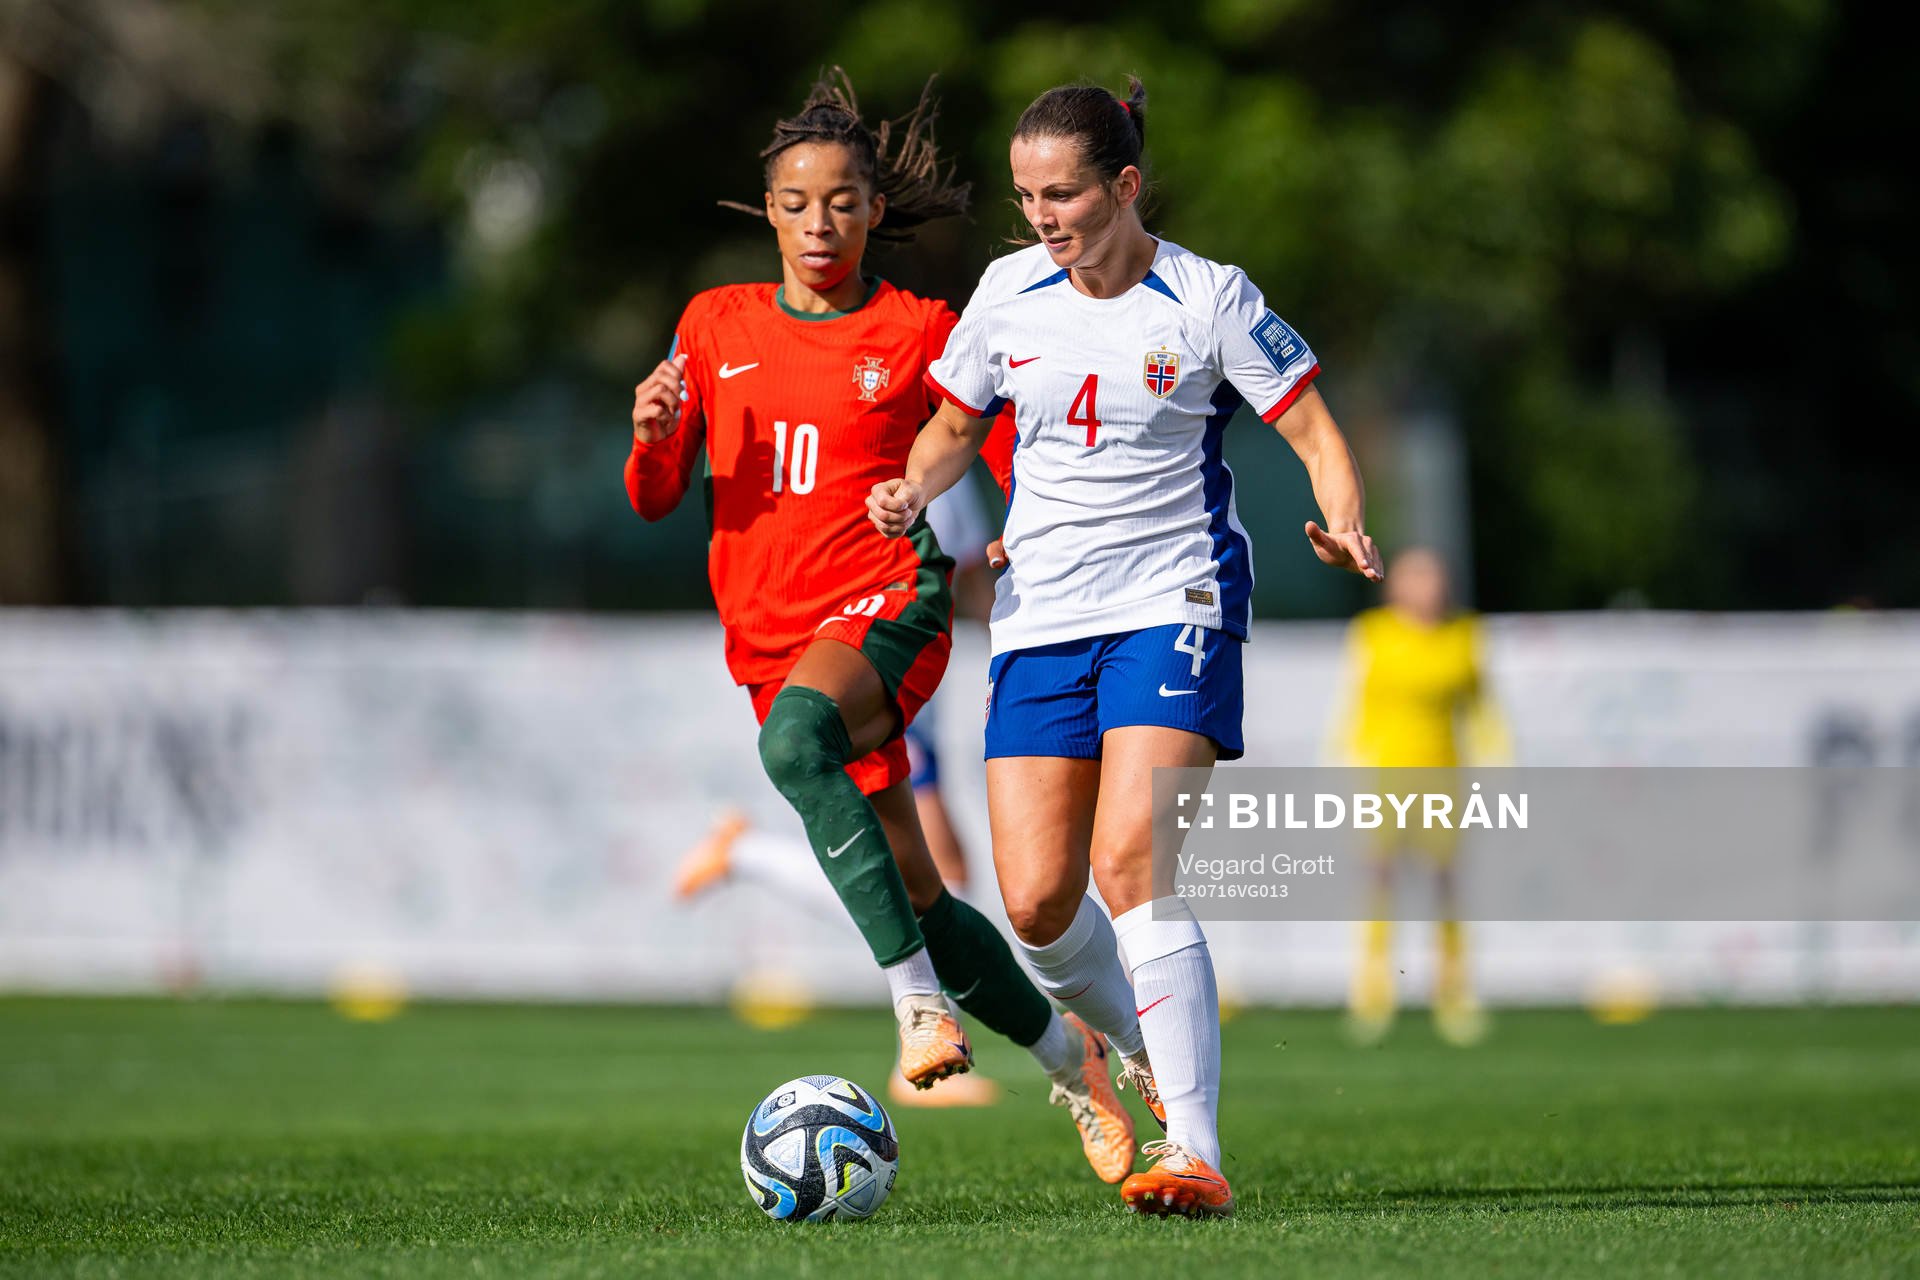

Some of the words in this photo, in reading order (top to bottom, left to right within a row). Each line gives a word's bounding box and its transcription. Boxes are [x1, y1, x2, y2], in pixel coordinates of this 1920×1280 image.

[1067, 373, 1102, 447] 4
[772, 421, 819, 495] 10
[1174, 624, 1206, 677] 4
